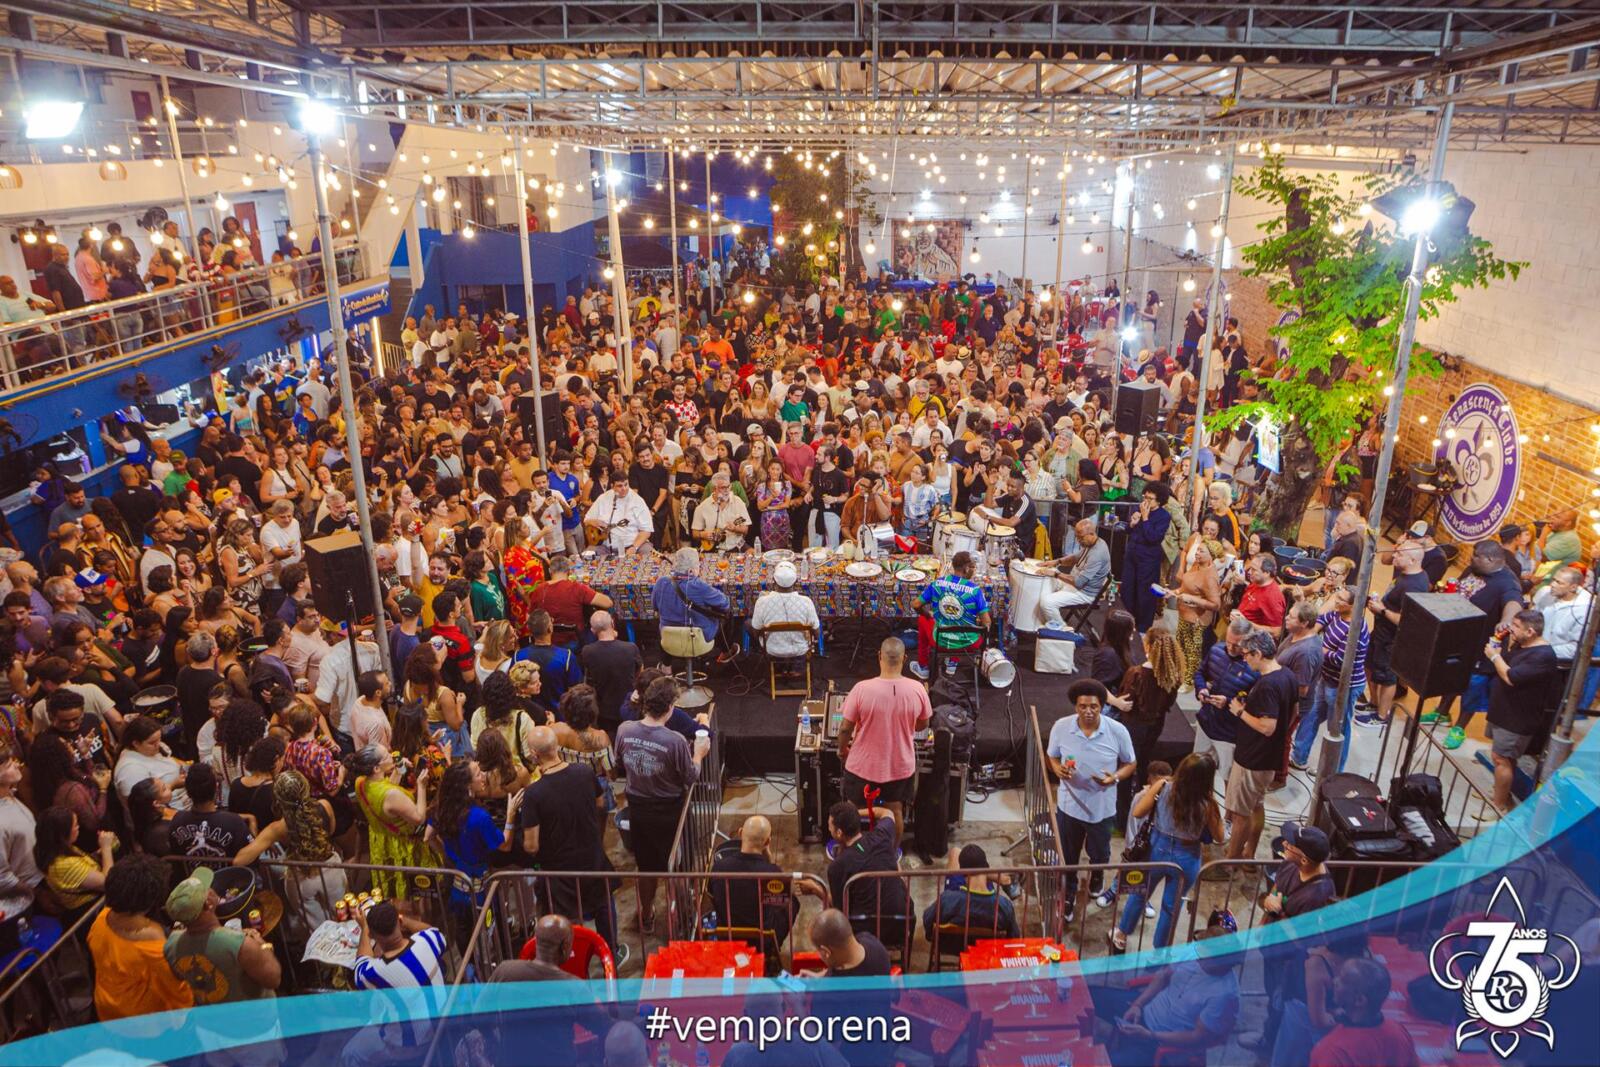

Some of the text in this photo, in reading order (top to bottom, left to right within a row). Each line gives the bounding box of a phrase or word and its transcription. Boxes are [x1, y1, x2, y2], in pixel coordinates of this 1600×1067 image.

[1497, 412, 1515, 466] Clube
[936, 579, 974, 593] COMPOSITOR
[1000, 956, 1039, 968] BRAHMA
